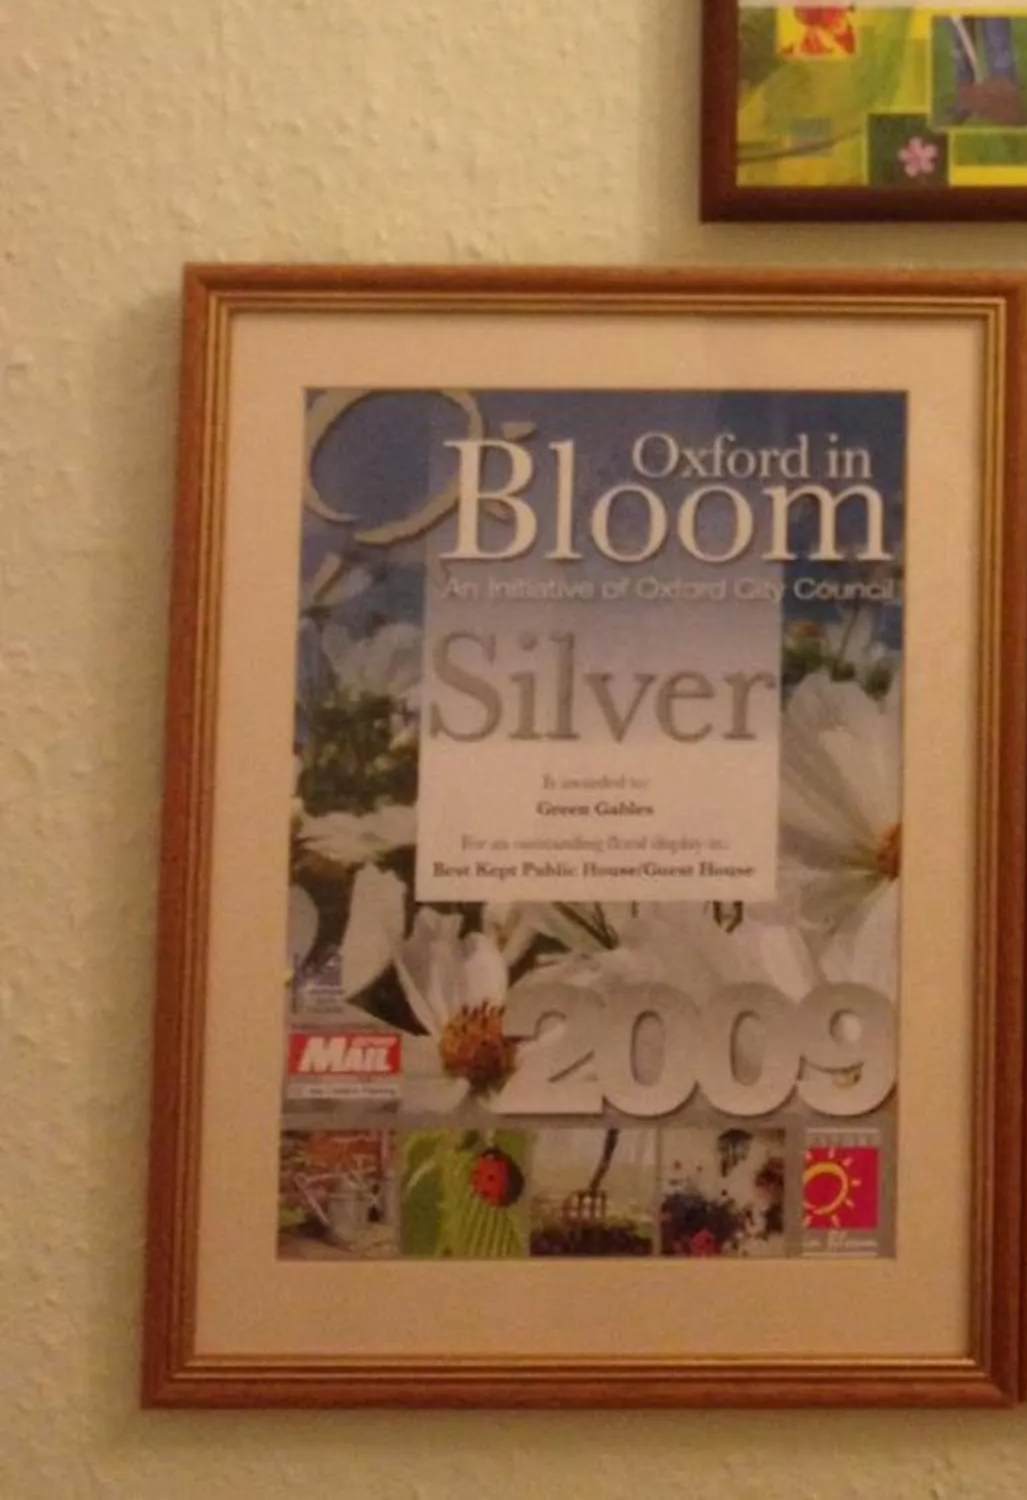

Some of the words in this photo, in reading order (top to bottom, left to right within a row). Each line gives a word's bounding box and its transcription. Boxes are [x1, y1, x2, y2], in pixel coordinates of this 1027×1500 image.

[632, 432, 809, 481] Oxford
[829, 433, 873, 480] in
[440, 438, 894, 564] Bloom
[443, 576, 480, 599] An
[488, 576, 595, 600] Initiative
[601, 576, 629, 600] of
[636, 576, 726, 600] Oxford
[733, 576, 786, 604] City
[794, 576, 895, 601] Council
[430, 630, 778, 744] Silver
[536, 800, 590, 818] Green
[594, 800, 655, 818] Gables
[433, 861, 471, 878] Best
[521, 861, 575, 878] Public
[698, 861, 757, 879] House
[297, 1036, 393, 1073] MAIL
[493, 982, 897, 1118] 2009
